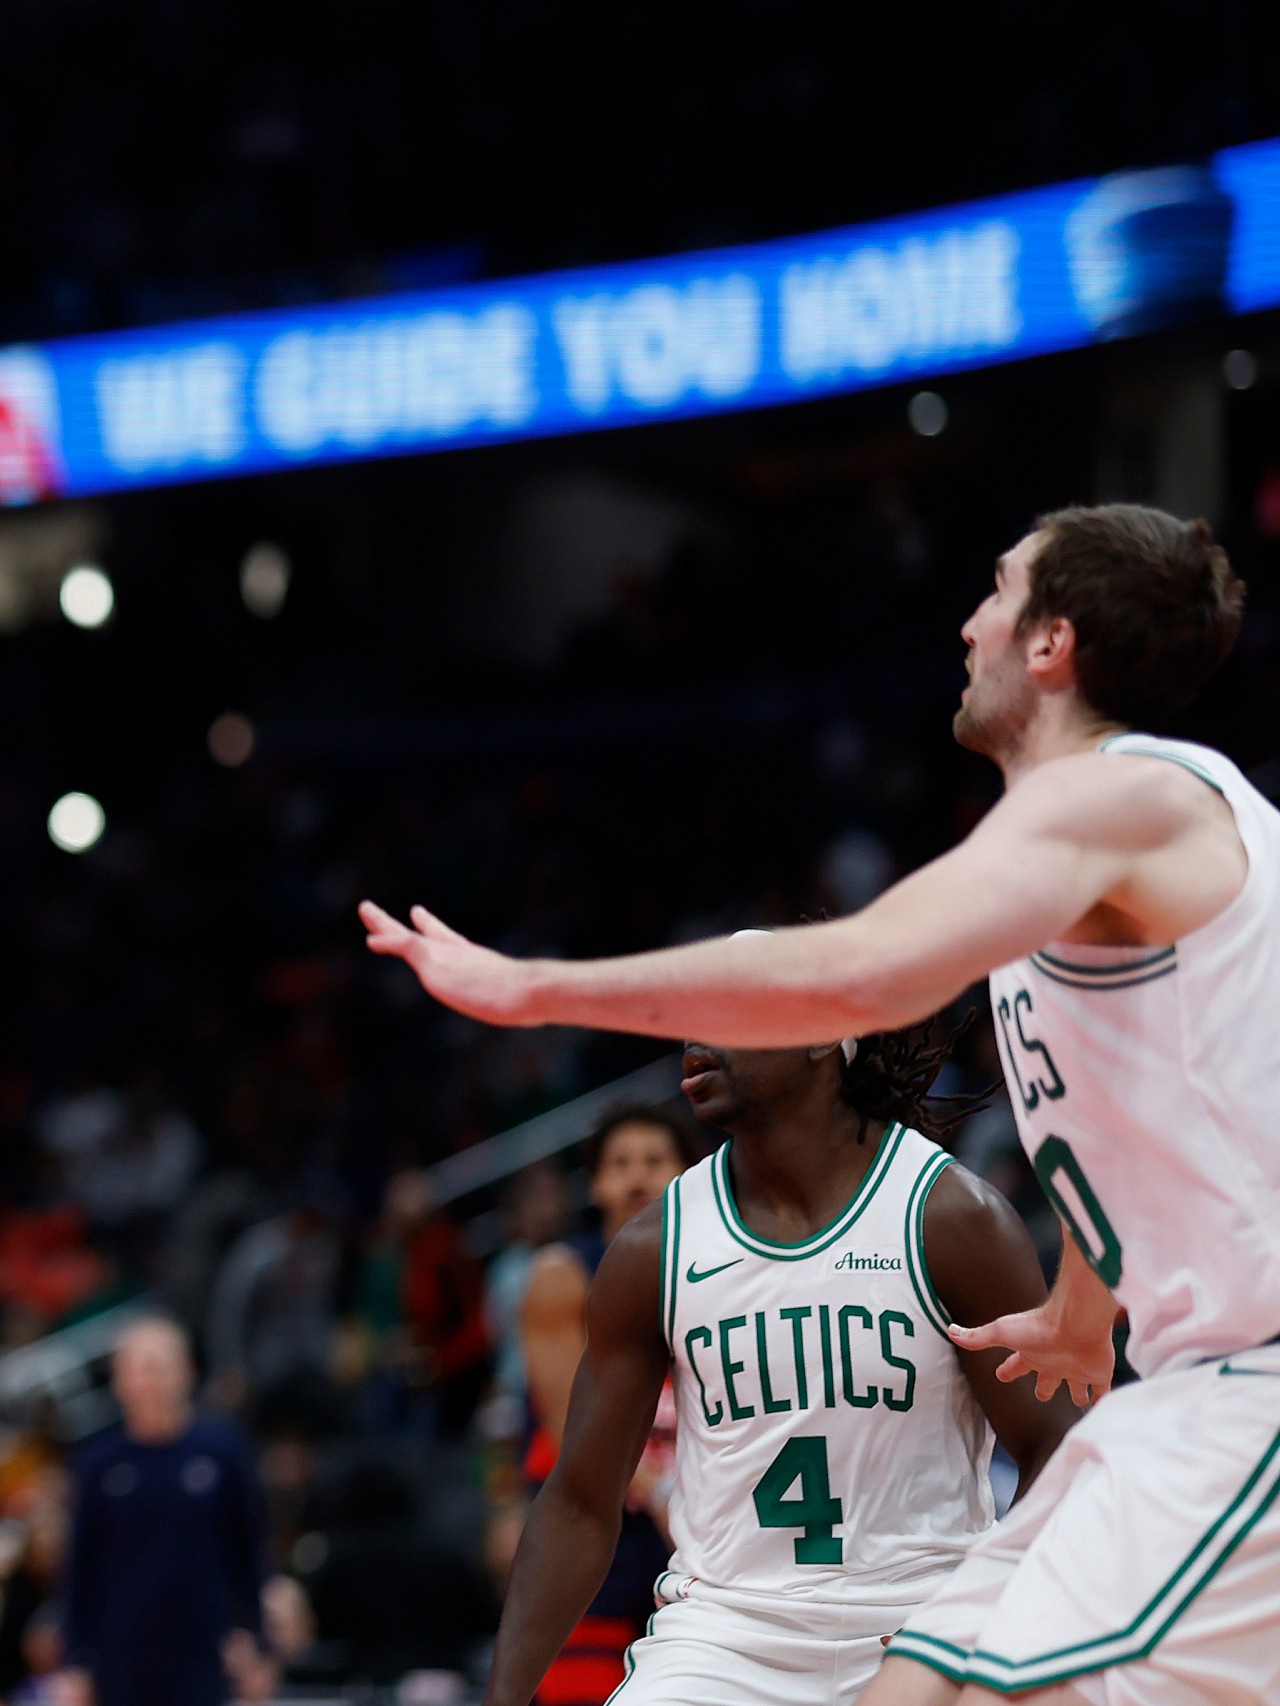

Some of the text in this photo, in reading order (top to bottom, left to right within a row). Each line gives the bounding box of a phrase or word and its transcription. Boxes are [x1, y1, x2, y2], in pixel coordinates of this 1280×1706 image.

[96, 346, 242, 470] WE
[554, 276, 761, 414] YOU
[835, 1251, 902, 1271] Amica
[685, 1304, 917, 1427] CELTICS
[752, 1435, 843, 1565] 4
